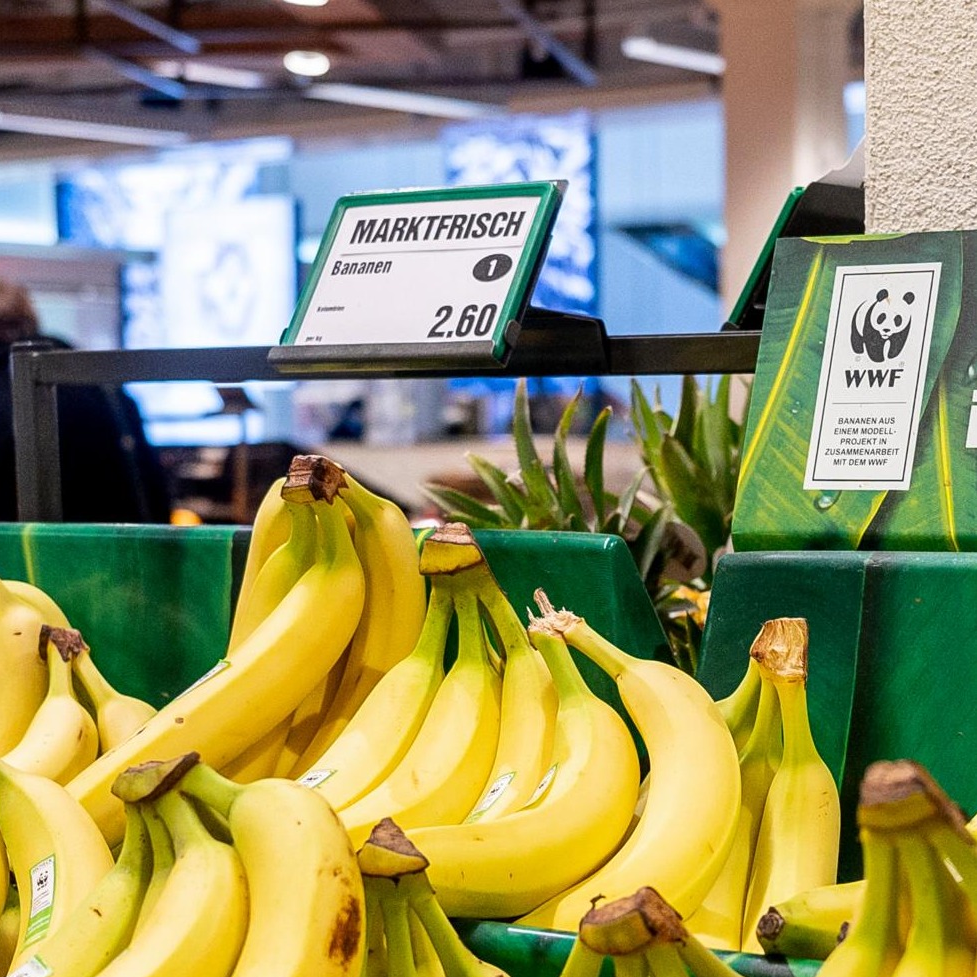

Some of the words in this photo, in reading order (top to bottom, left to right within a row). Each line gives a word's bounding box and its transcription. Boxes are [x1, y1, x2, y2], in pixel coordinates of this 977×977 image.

[349, 211, 527, 245] MARKTFRISCH
[330, 260, 393, 276] Bananen
[487, 259, 498, 277] 1
[426, 303, 498, 339] 2.60
[845, 369, 904, 388] WWF
[838, 417, 877, 425] BANANEN
[878, 417, 896, 425] AUS
[833, 427, 859, 435] EINEM
[860, 427, 897, 435] MODELL-
[825, 448, 899, 456] ZUSAMMENARBEIT
[833, 458, 847, 466] MIT
[848, 458, 866, 466] DEM
[868, 458, 888, 466] WWF
